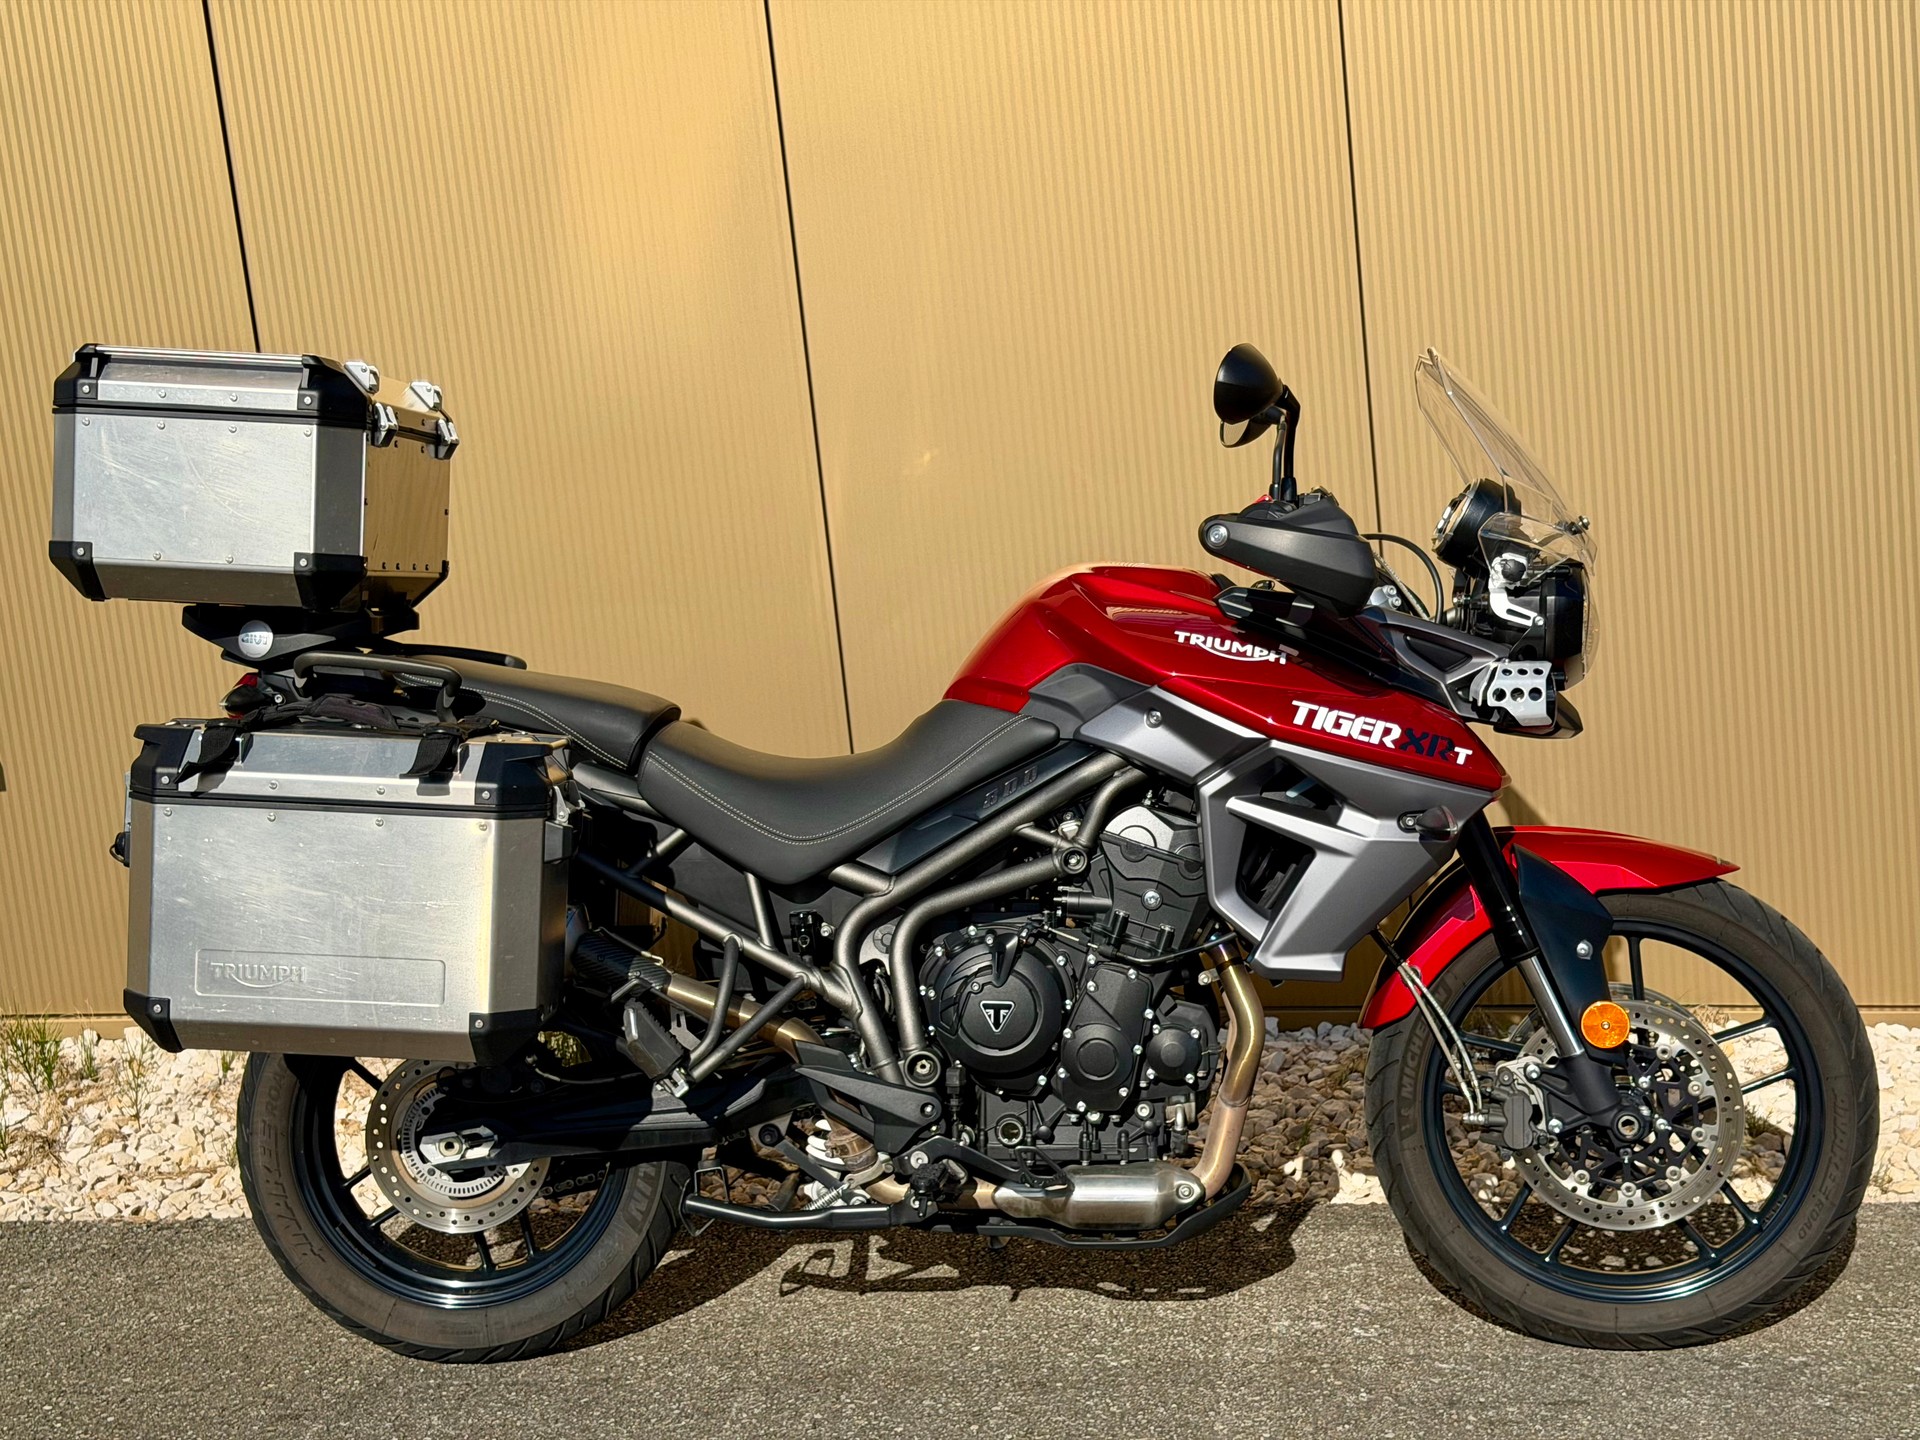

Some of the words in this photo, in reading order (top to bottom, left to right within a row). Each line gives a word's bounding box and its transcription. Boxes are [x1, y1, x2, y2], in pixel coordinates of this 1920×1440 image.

[1174, 630, 1287, 665] TRIUMPH
[1291, 699, 1402, 749] TIGER
[209, 962, 308, 986] TRIUMPH
[1400, 983, 1451, 1101] MICHEN
